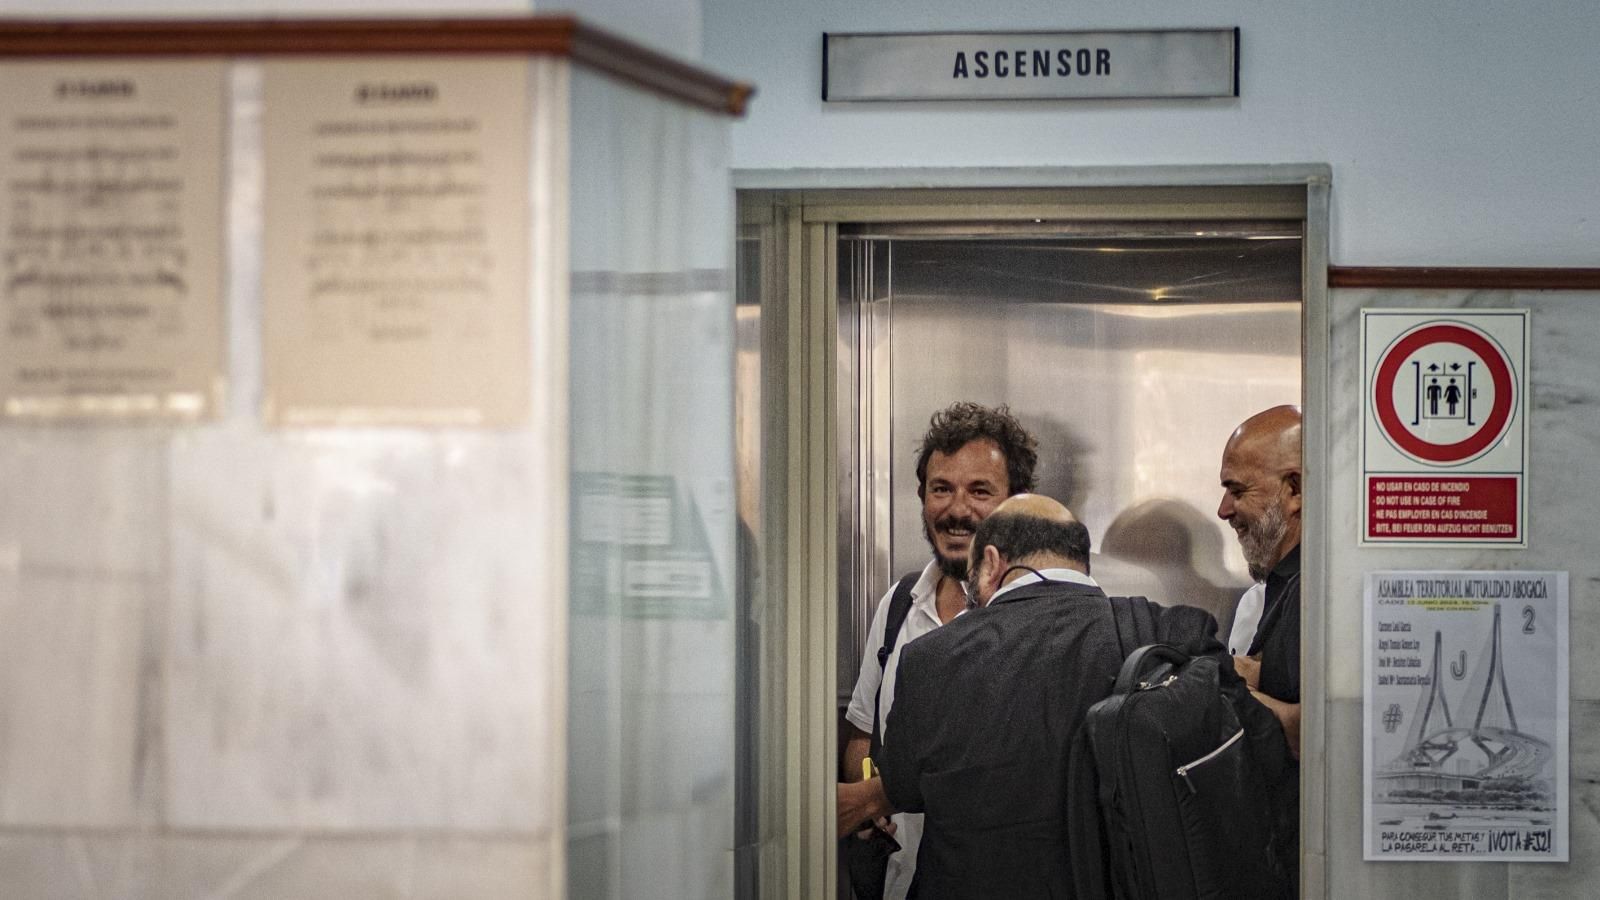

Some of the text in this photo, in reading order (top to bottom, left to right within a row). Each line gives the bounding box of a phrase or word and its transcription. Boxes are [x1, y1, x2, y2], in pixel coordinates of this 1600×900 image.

[953, 48, 1111, 78] ASCENSOR
[1376, 481, 1470, 492] NO USAR EN CASO DE INCENDIO
[1376, 495, 1461, 506] DO NOT USE IN CASE OF FIRE
[1376, 509, 1385, 520] NE
[1385, 509, 1398, 520] PAS
[1398, 509, 1431, 520] EMPLOYER
[1431, 509, 1440, 520] EN
[1441, 509, 1453, 520] CAS
[1403, 523, 1422, 534] FEUER
[1424, 523, 1437, 534] DEN
[1437, 523, 1461, 534] AUFZUG
[1462, 523, 1480, 534] NICHT
[1481, 523, 1513, 534] BENUTZEN
[1378, 577, 1548, 598] ASAMBLEA TERRITORIAL MUTUALIDAD ABOGACÍA
[1522, 605, 1536, 635] 2
[1450, 650, 1467, 681] J
[1382, 832, 1398, 841] PARA
[1439, 832, 1453, 841] TUS
[1454, 832, 1479, 841] METAS
[1382, 843, 1393, 853] LA
[1439, 843, 1450, 853] AL
